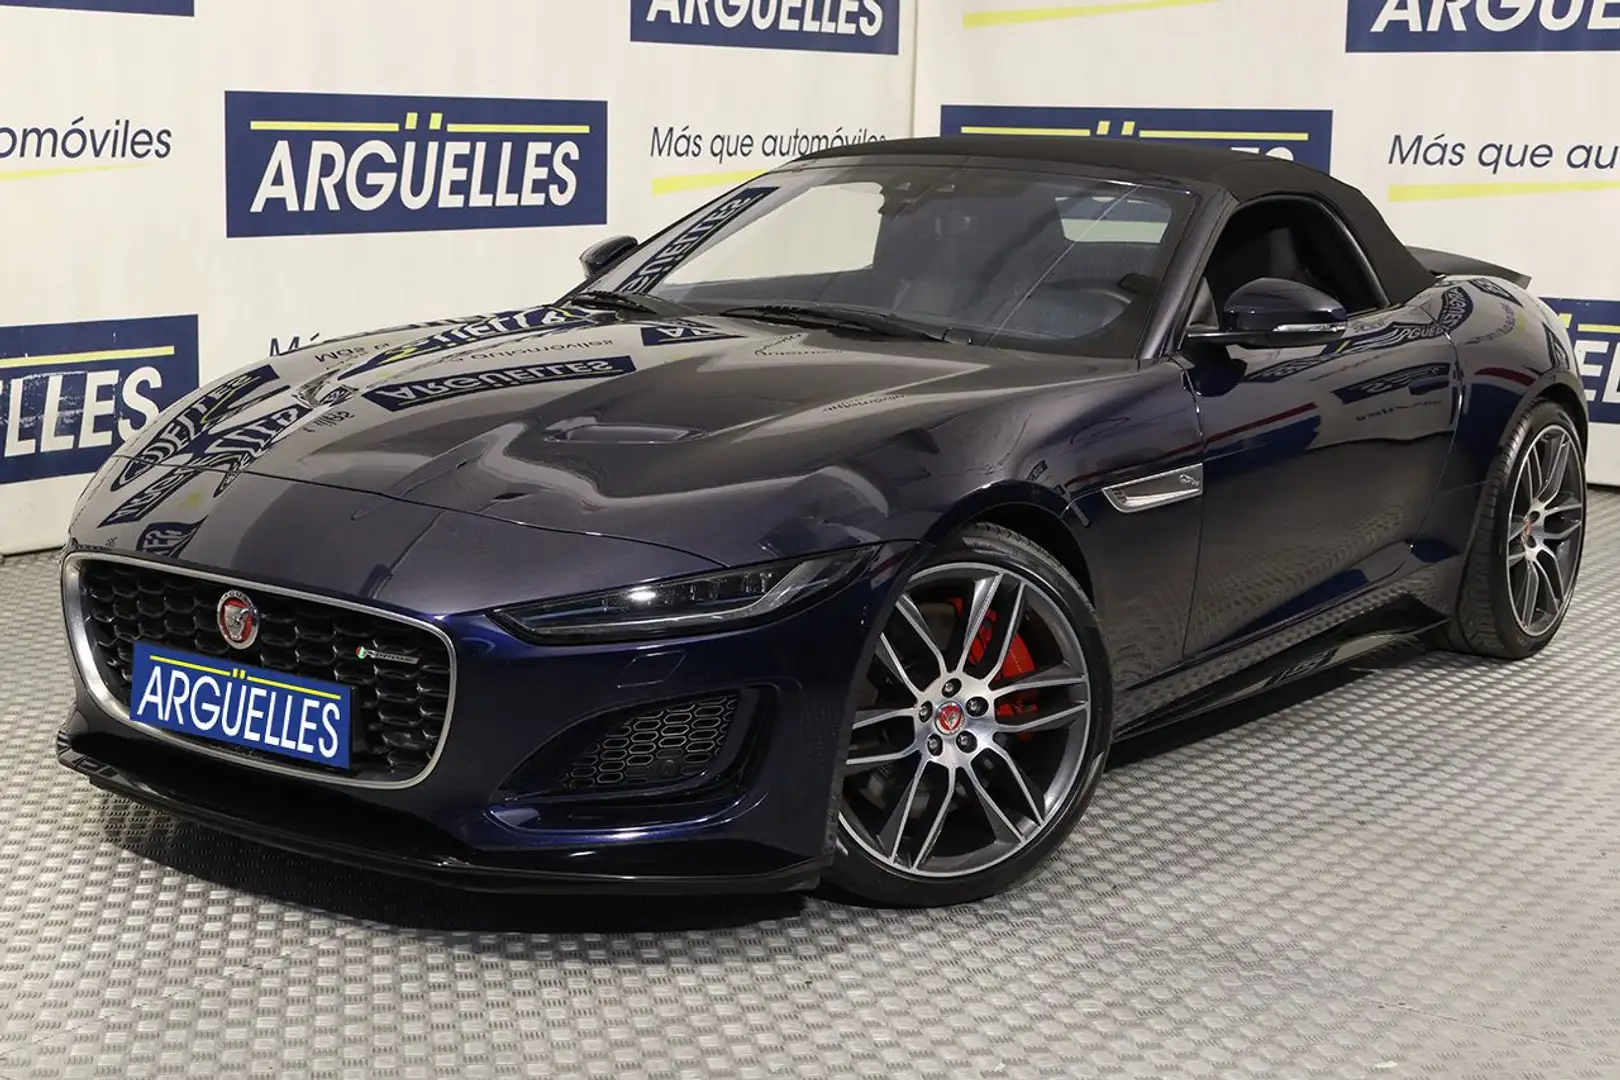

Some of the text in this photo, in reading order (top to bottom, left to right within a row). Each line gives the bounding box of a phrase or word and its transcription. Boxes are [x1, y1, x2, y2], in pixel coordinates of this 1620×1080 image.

[0, 116, 172, 159] omóviles
[250, 112, 580, 212] ARGÜELLES
[650, 125, 702, 157] Más
[710, 134, 754, 164] que
[1388, 133, 1466, 166] Más
[1478, 143, 1553, 175] que
[0, 366, 162, 457] LLES
[137, 666, 341, 758] ARGÜELLES
